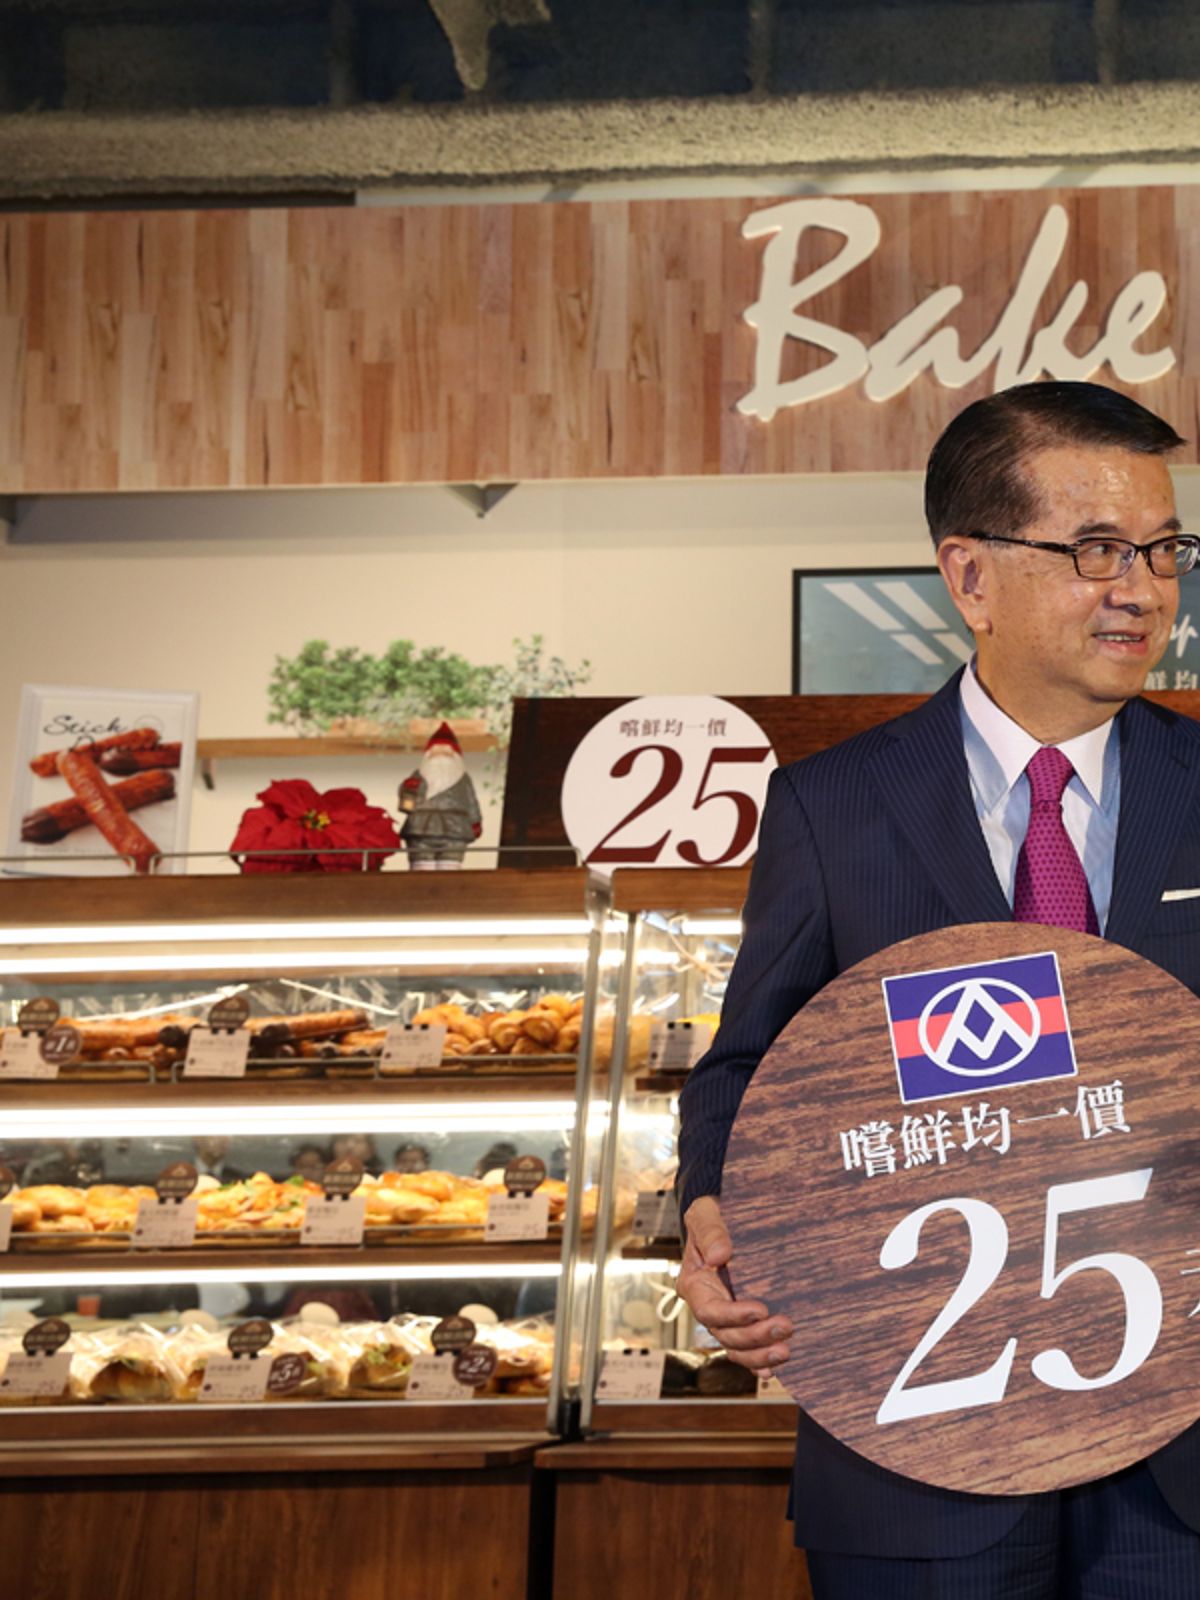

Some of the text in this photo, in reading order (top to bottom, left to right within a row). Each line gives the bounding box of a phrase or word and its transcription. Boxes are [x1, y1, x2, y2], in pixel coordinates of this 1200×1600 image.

[737, 198, 1177, 421] Bake
[43, 713, 125, 737] Stick
[584, 744, 772, 867] 25
[839, 1079, 1131, 1177] 嚐鮮均一價
[876, 1167, 1163, 1425] 25
